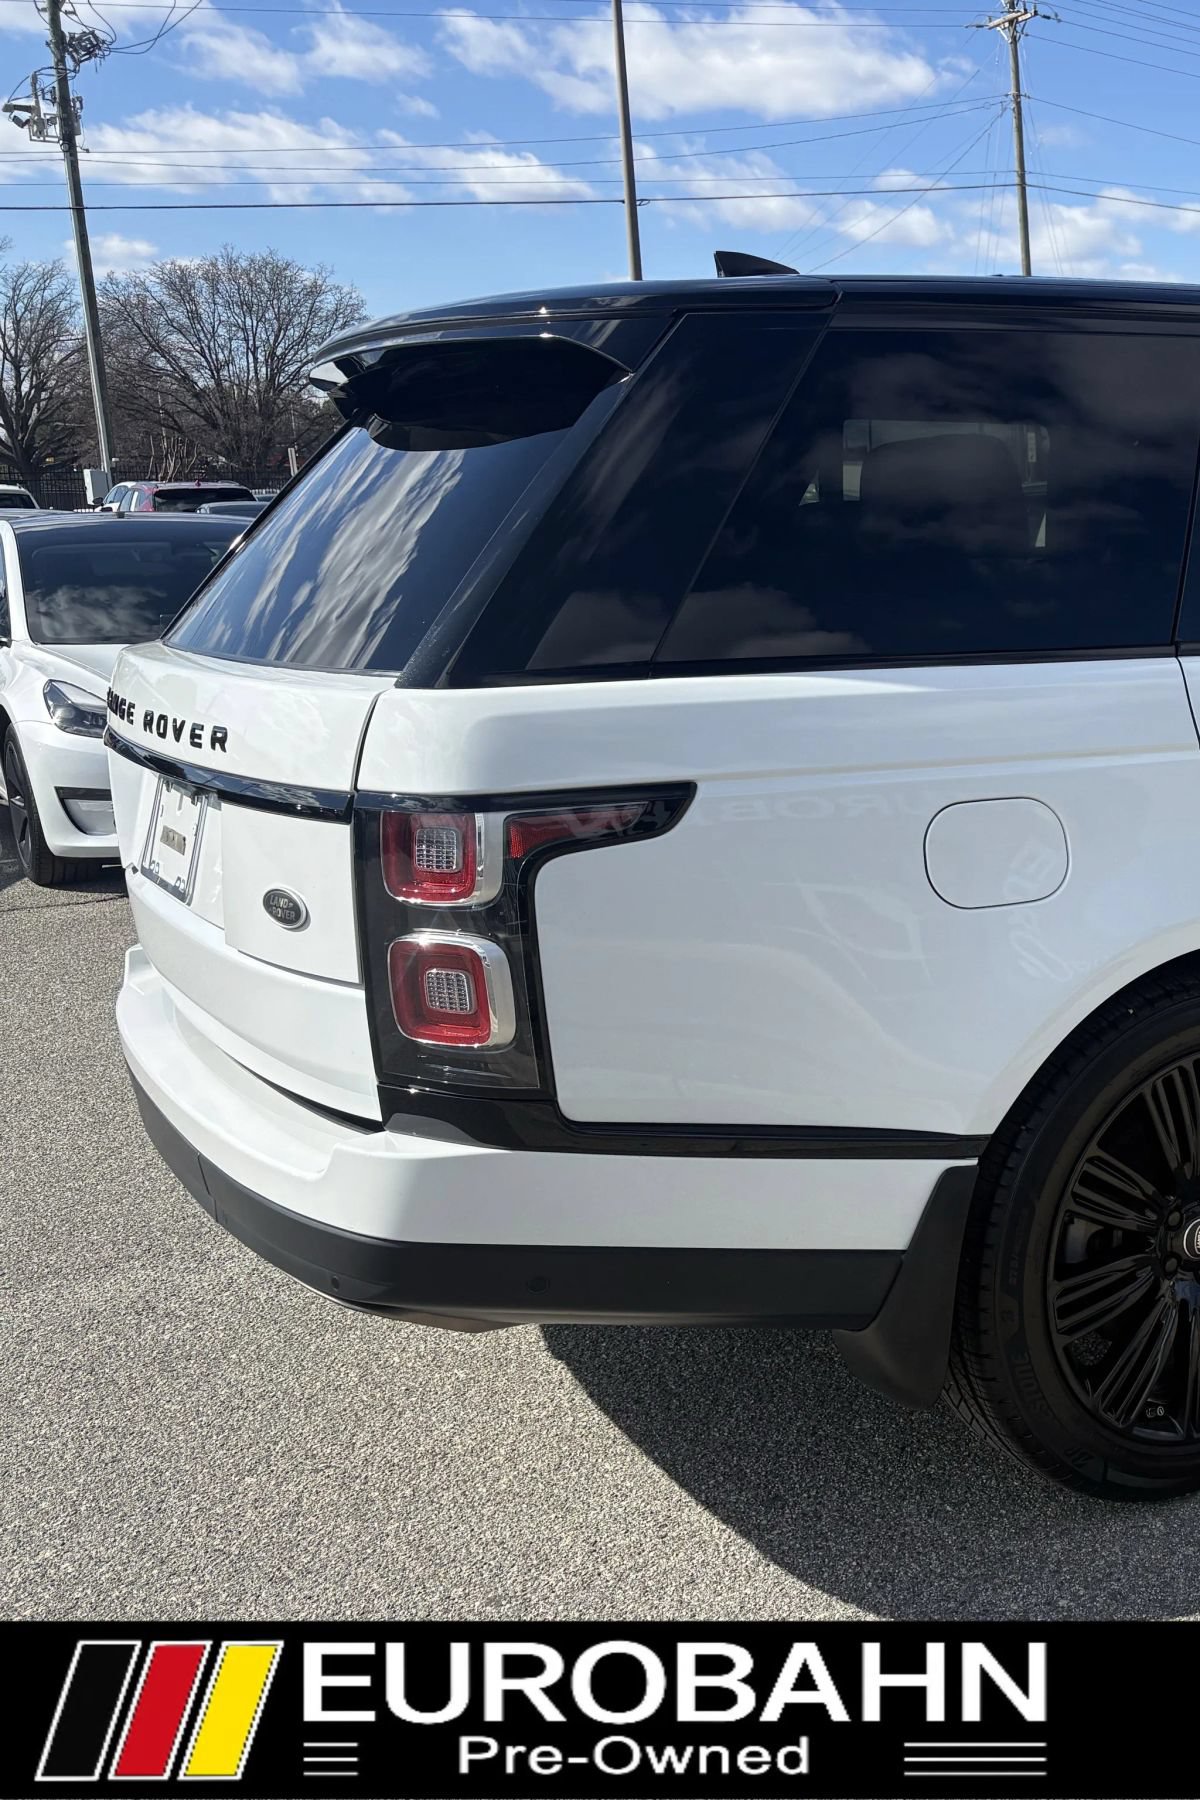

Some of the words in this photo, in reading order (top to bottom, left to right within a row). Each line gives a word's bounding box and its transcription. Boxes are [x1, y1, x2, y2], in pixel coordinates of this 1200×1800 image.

[143, 709, 229, 753] ROVER
[269, 894, 289, 909] LAND
[272, 906, 296, 921] ROVER
